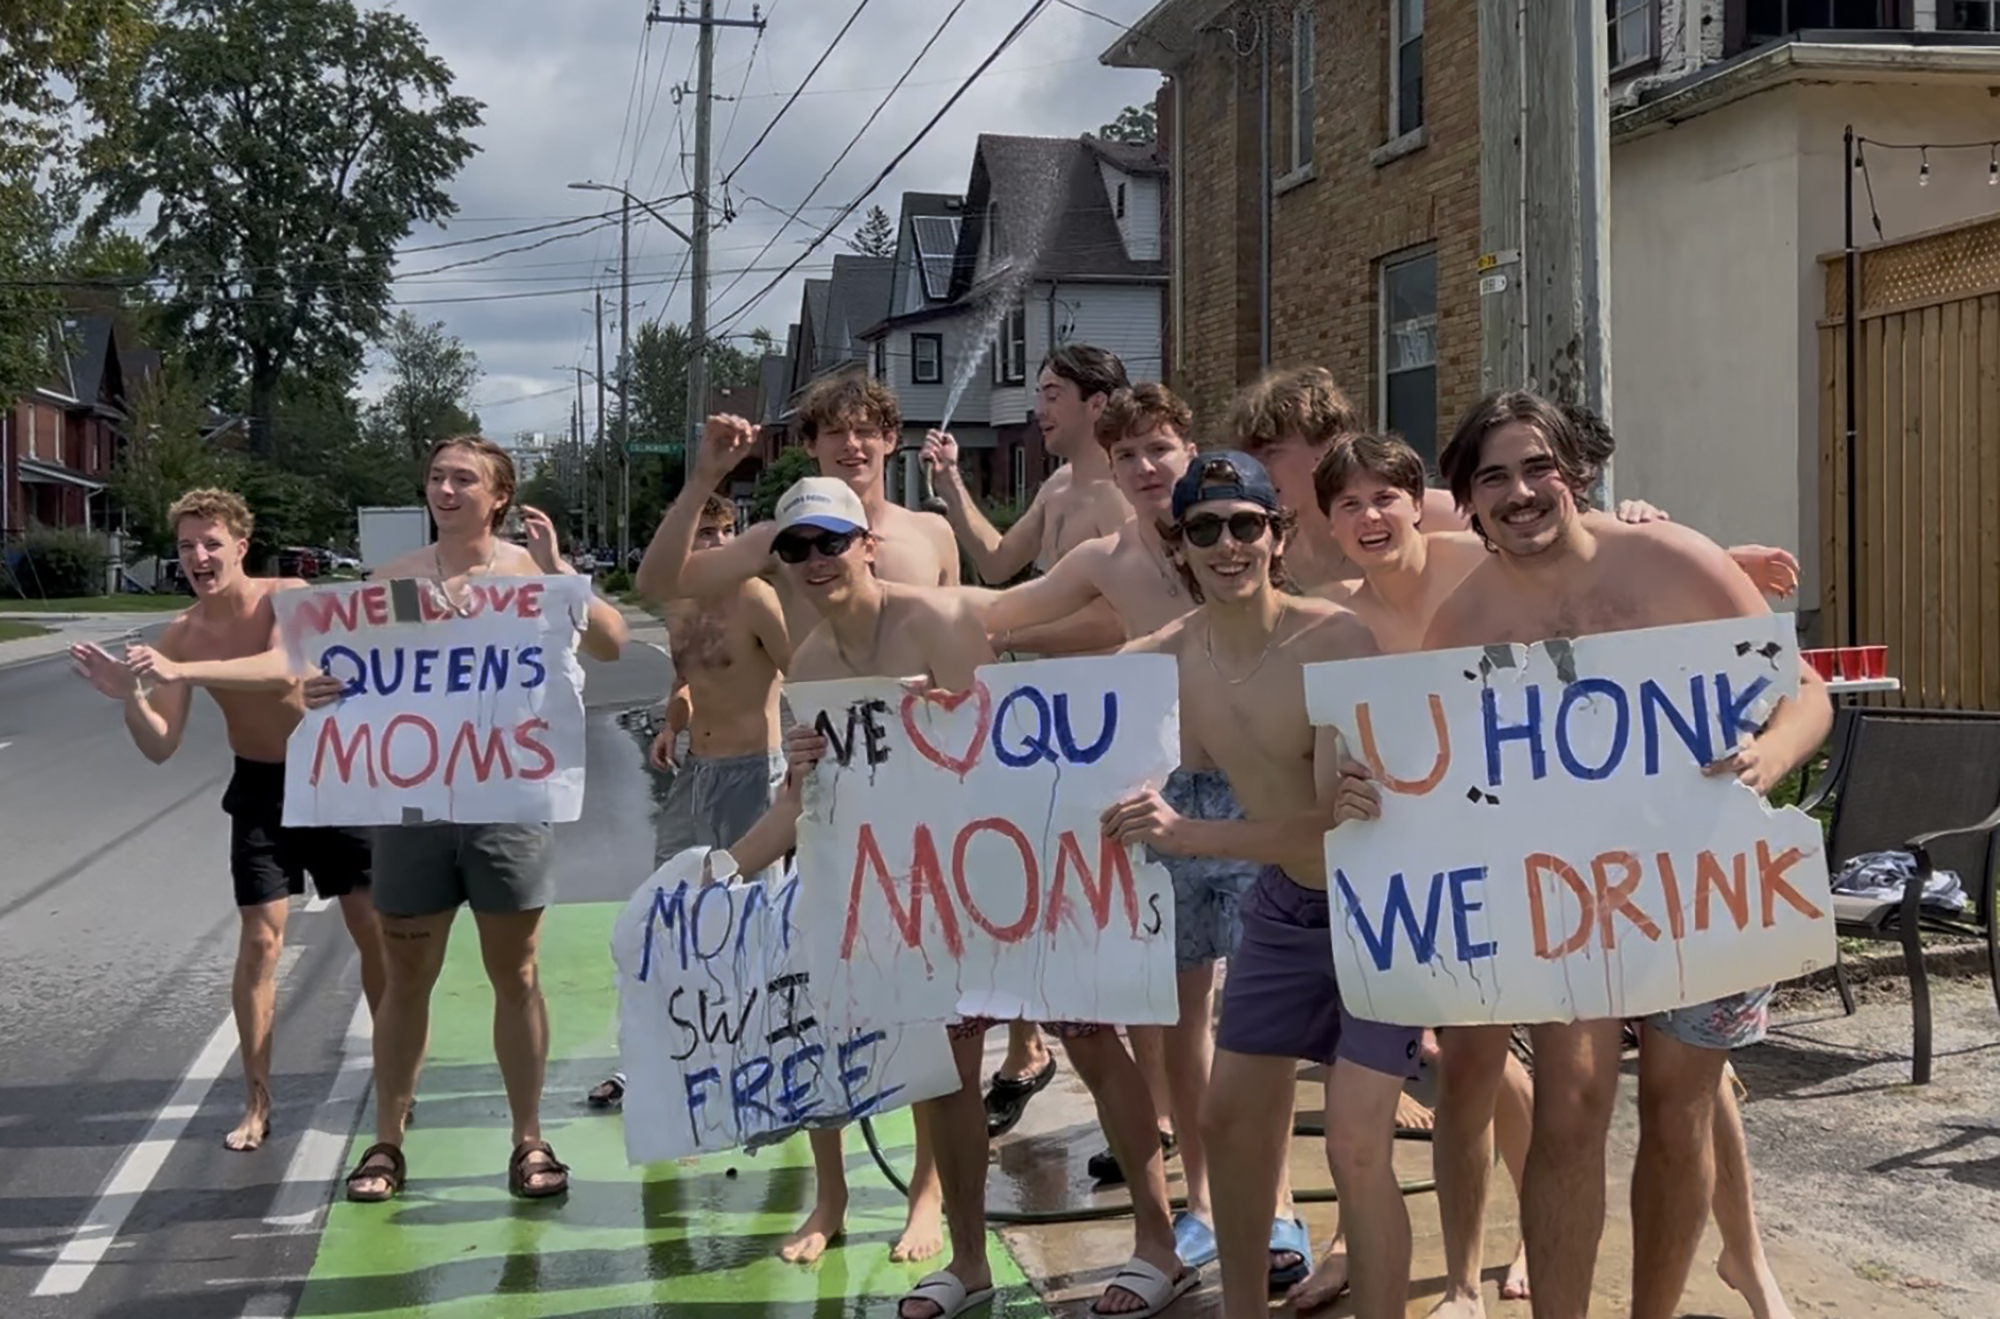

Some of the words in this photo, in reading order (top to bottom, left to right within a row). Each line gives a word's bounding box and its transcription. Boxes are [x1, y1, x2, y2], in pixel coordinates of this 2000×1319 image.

[292, 586, 387, 635] WE
[309, 713, 556, 789] MOMS
[991, 685, 1118, 768] QU
[1355, 693, 1452, 796] U
[1482, 672, 1773, 787] HONK
[1335, 865, 1499, 972] WE
[1524, 839, 1825, 961] DRINK
[683, 1028, 907, 1148] FREE
